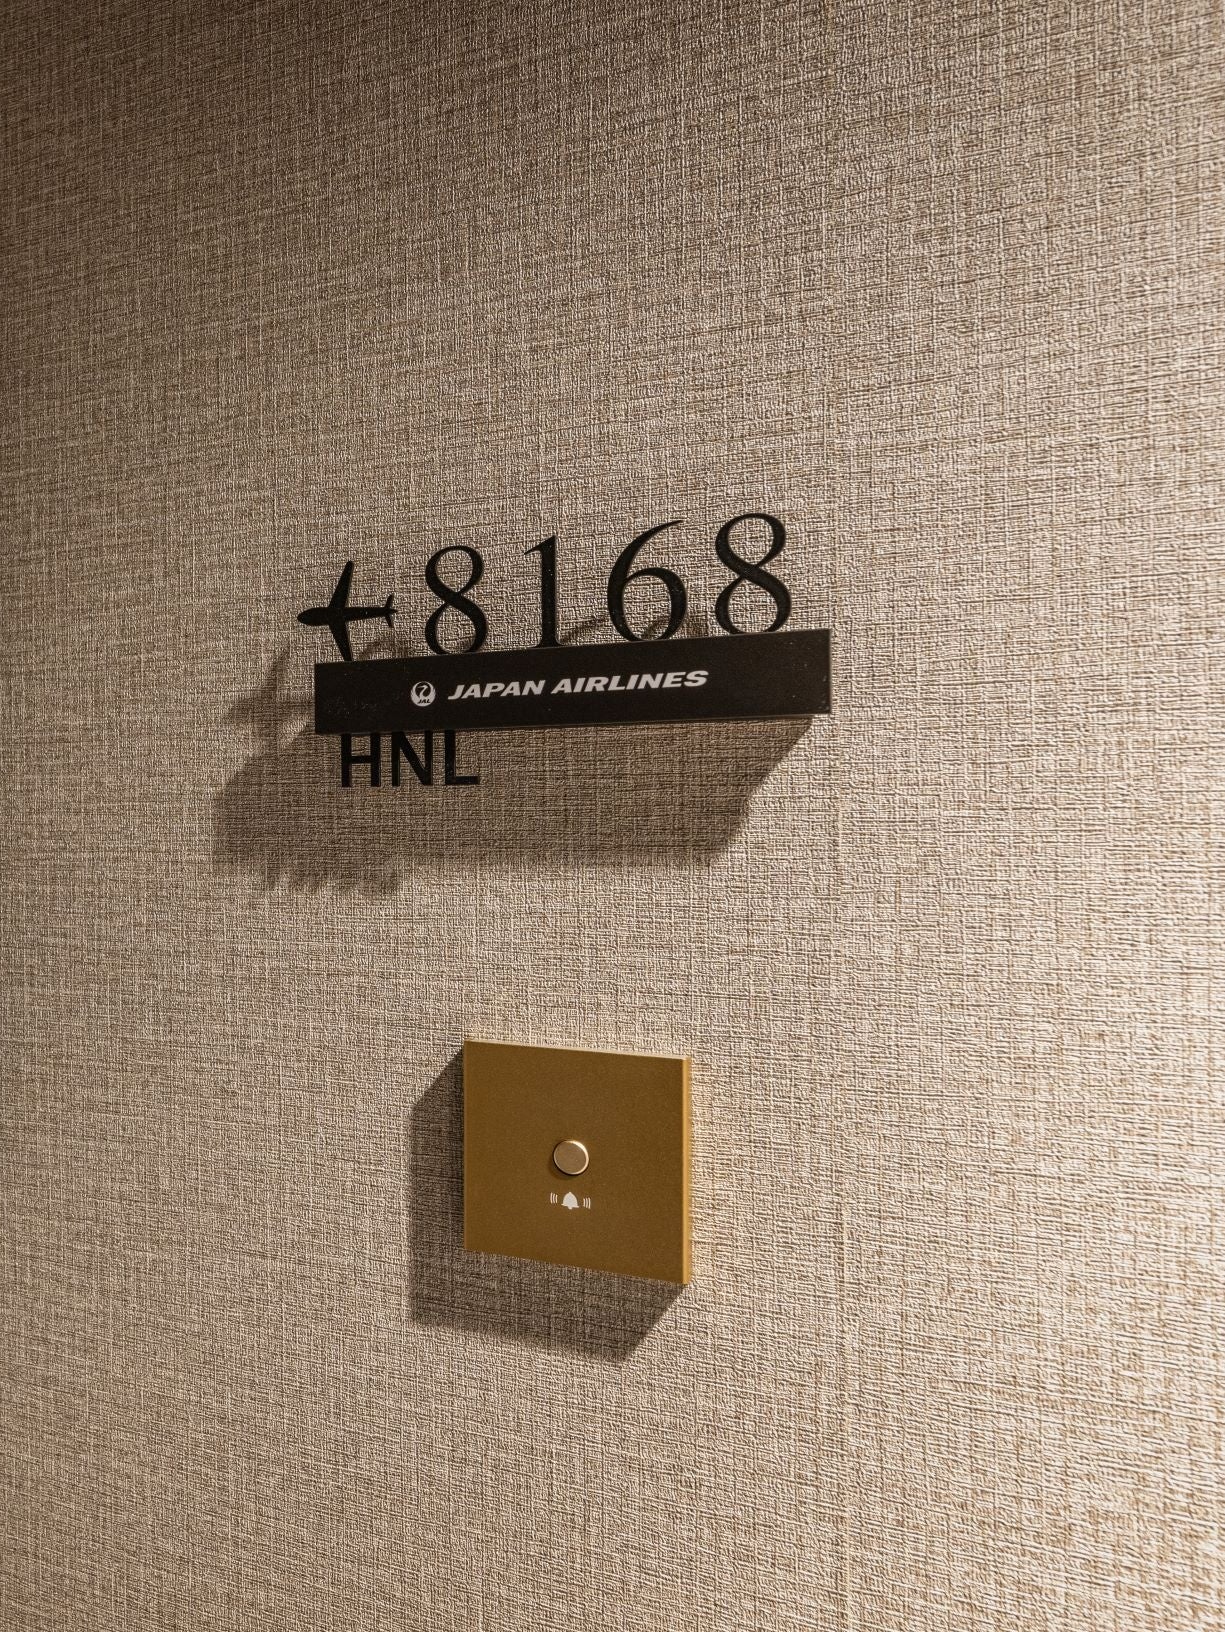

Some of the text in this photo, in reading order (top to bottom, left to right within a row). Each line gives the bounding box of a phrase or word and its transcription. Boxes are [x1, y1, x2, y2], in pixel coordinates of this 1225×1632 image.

[425, 513, 793, 654] 8168
[448, 670, 709, 700] JAPAN AIRLINES
[341, 729, 479, 788] HNL
